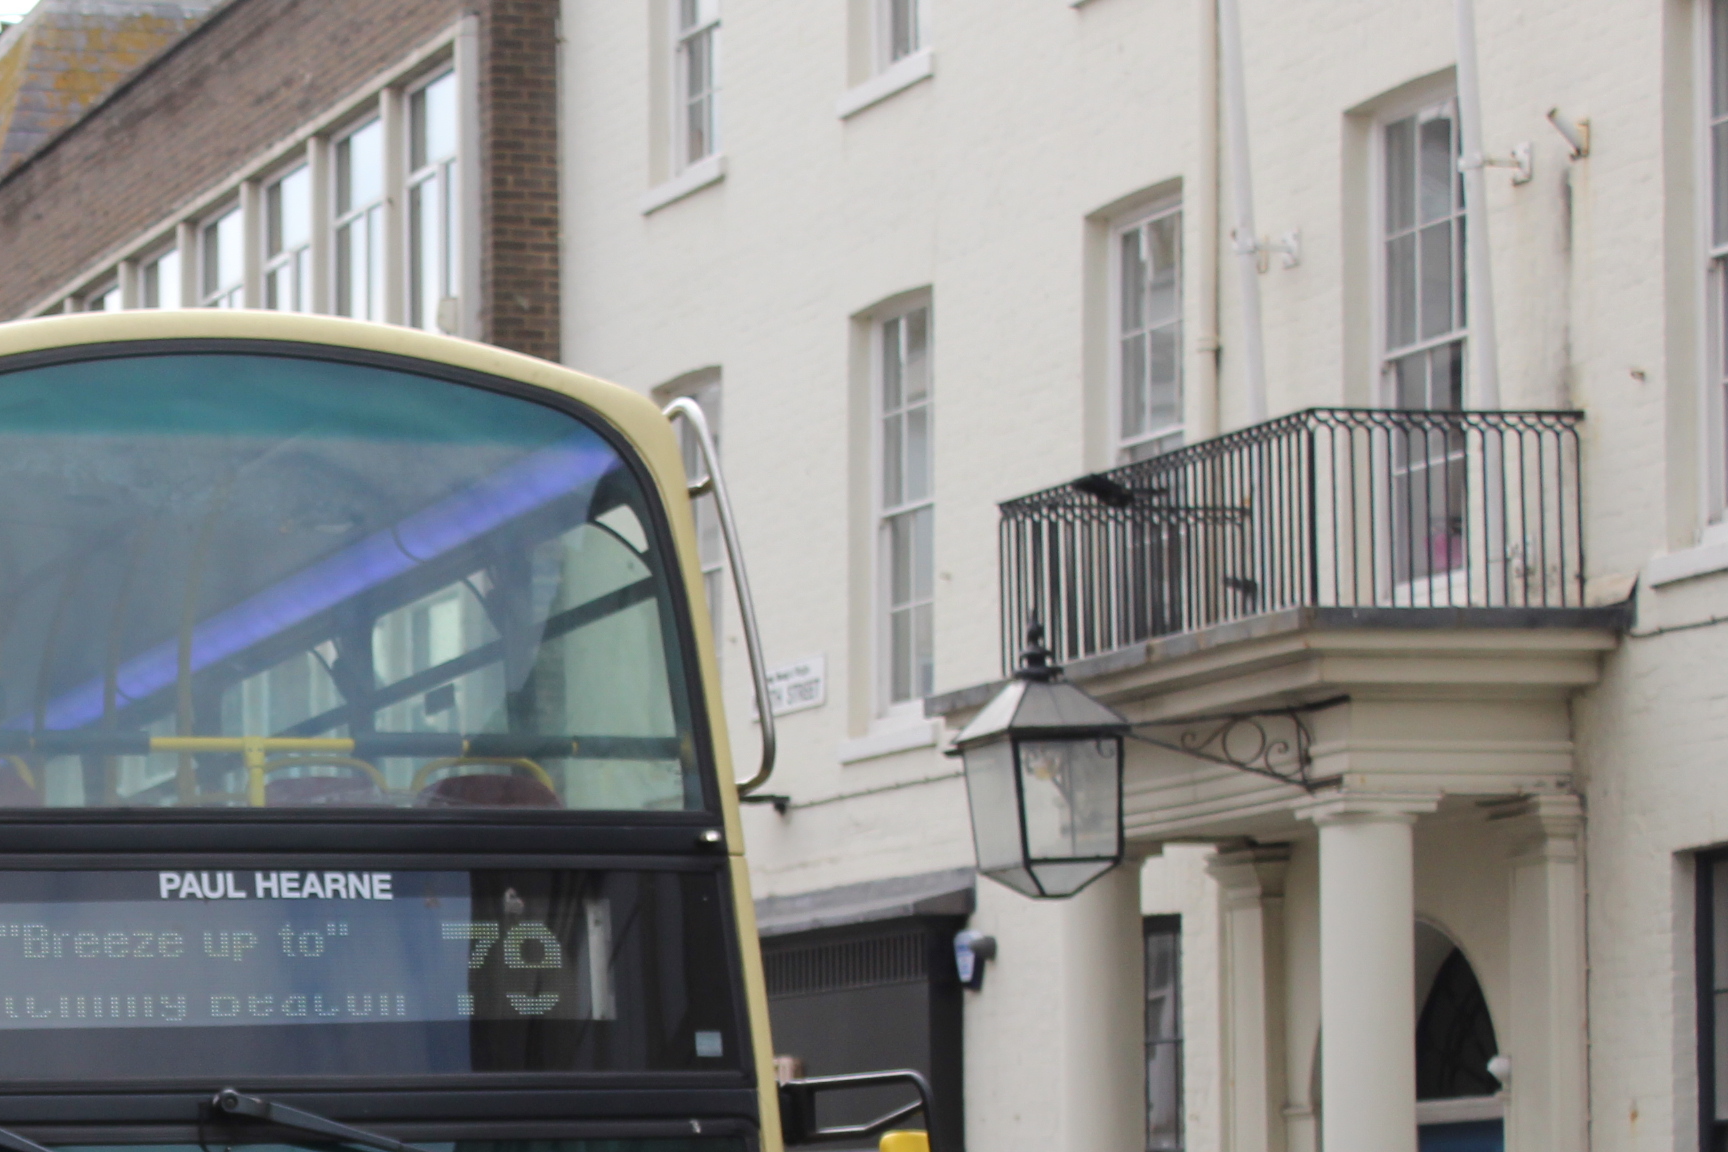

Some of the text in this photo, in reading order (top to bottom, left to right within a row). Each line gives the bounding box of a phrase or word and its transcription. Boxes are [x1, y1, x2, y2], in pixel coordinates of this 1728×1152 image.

[159, 872, 393, 900] PAUL HEARNE
[202, 930, 259, 962] up
